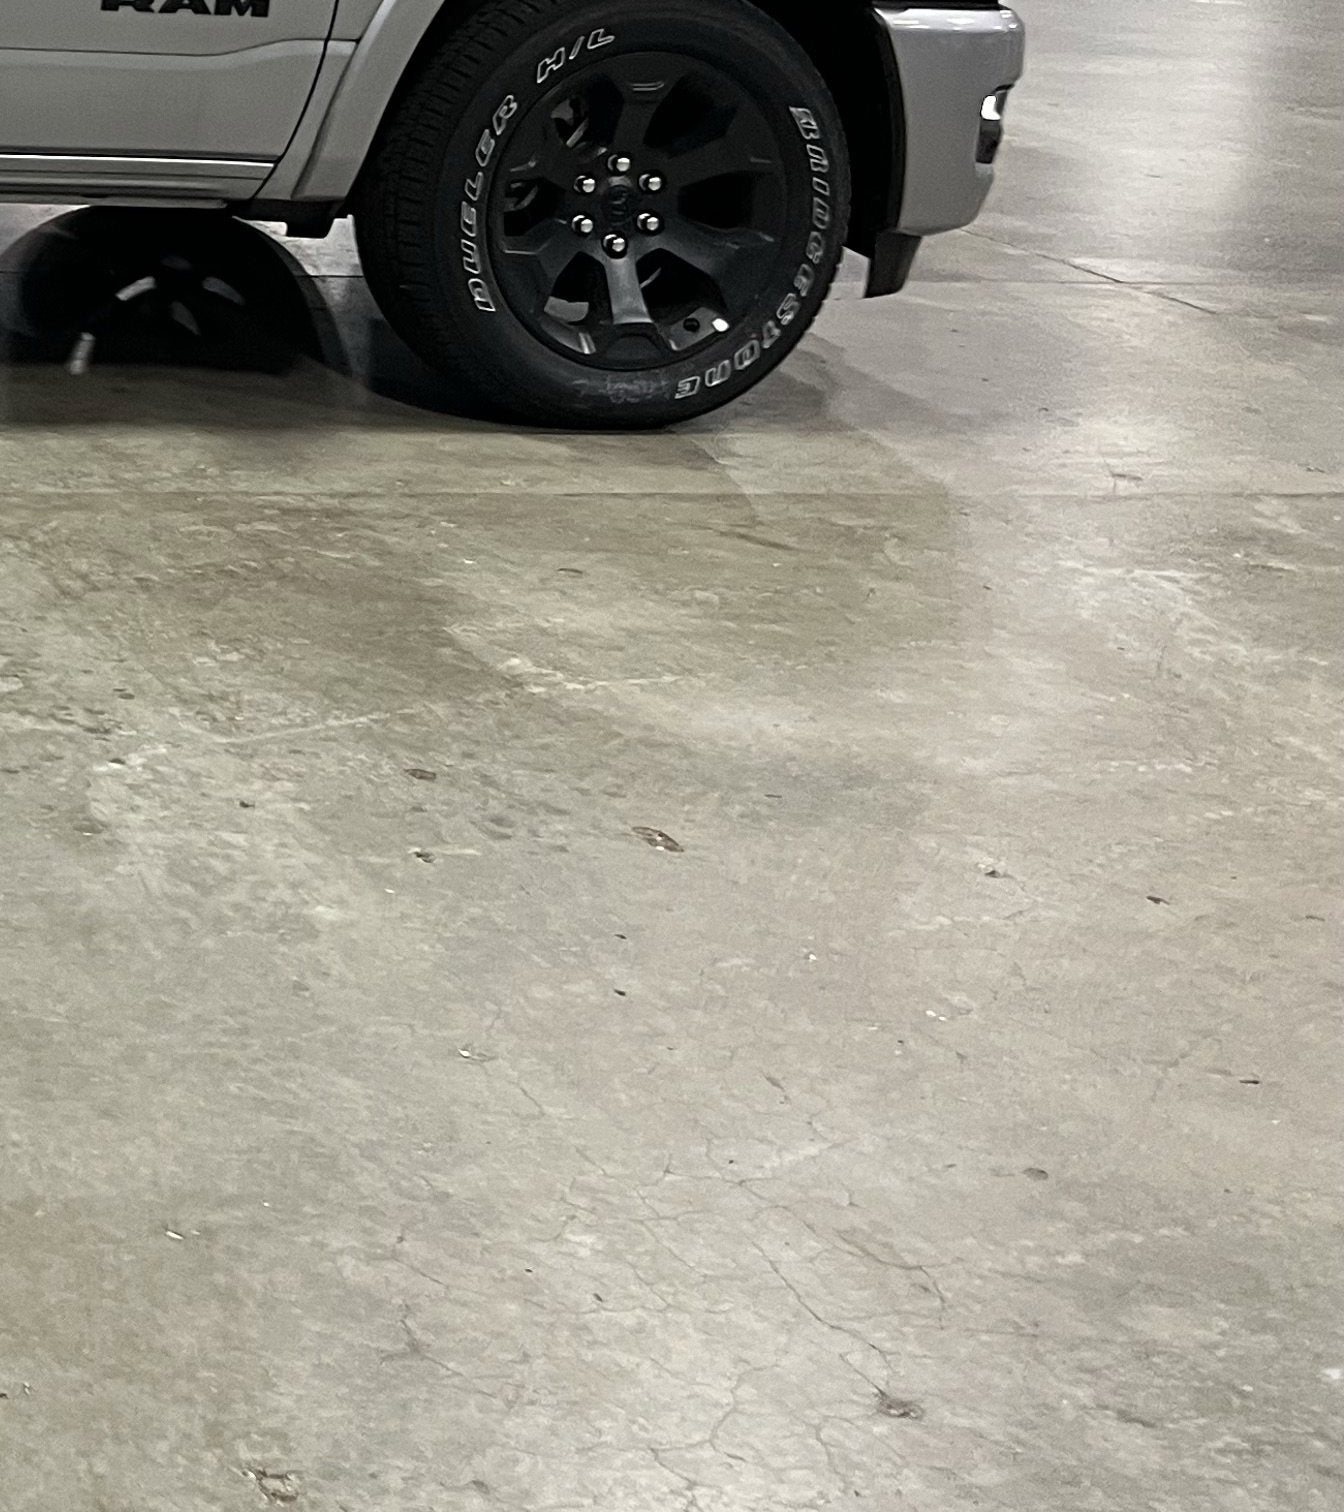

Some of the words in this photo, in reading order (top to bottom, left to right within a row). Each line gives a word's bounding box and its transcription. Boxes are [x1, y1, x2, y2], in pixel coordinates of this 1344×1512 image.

[461, 95, 518, 312] DUELER
[536, 29, 615, 84] H/L
[674, 106, 830, 399] BRIDGESTONE
